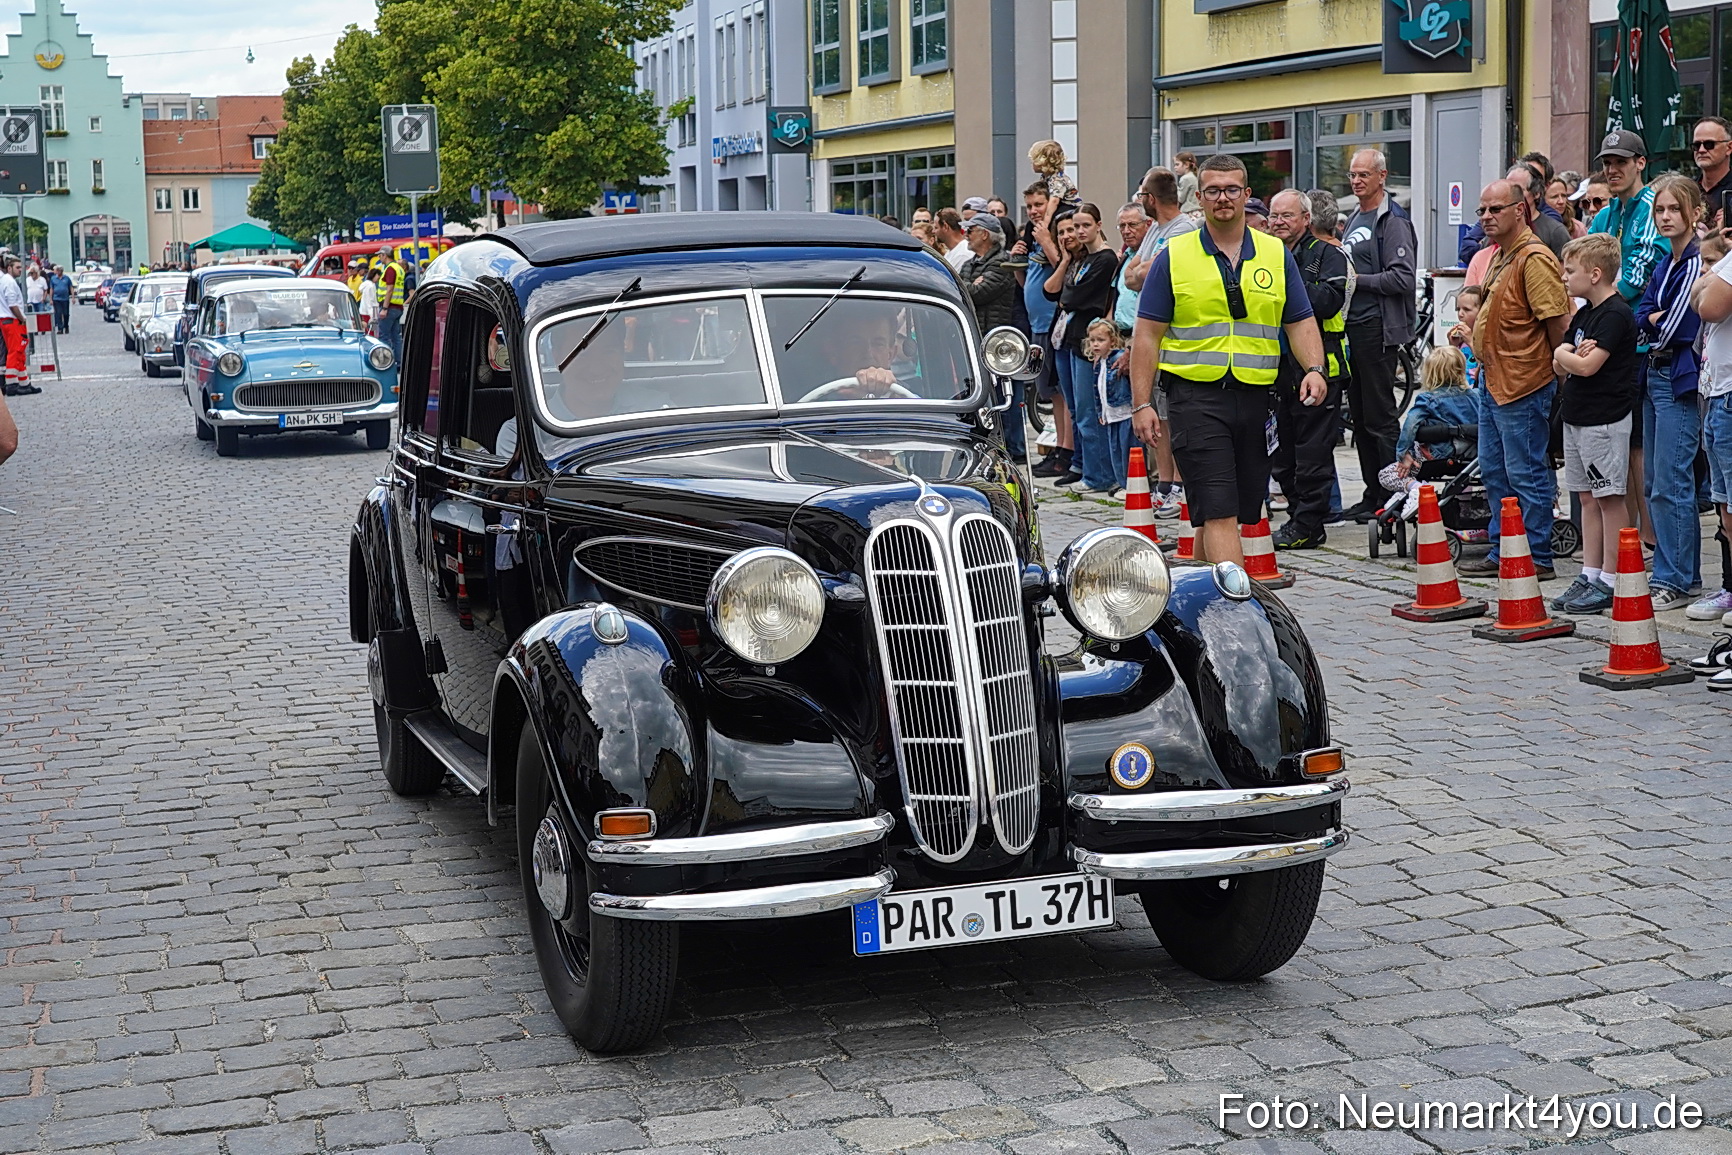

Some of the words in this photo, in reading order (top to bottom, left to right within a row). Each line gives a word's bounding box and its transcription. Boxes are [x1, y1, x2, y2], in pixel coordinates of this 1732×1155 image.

[1420, 2, 1450, 41] G2
[783, 119, 799, 138] G2
[7, 144, 28, 152] ZONE
[401, 143, 421, 151] ZONE
[382, 223, 392, 231] Die
[393, 221, 429, 230] Knödeltter
[286, 415, 300, 426] AN
[306, 413, 320, 424] PK
[322, 412, 336, 424] 5H
[882, 896, 956, 945] PAR
[984, 889, 1032, 933] TL
[1041, 879, 1110, 925] 37H
[862, 931, 872, 945] D
